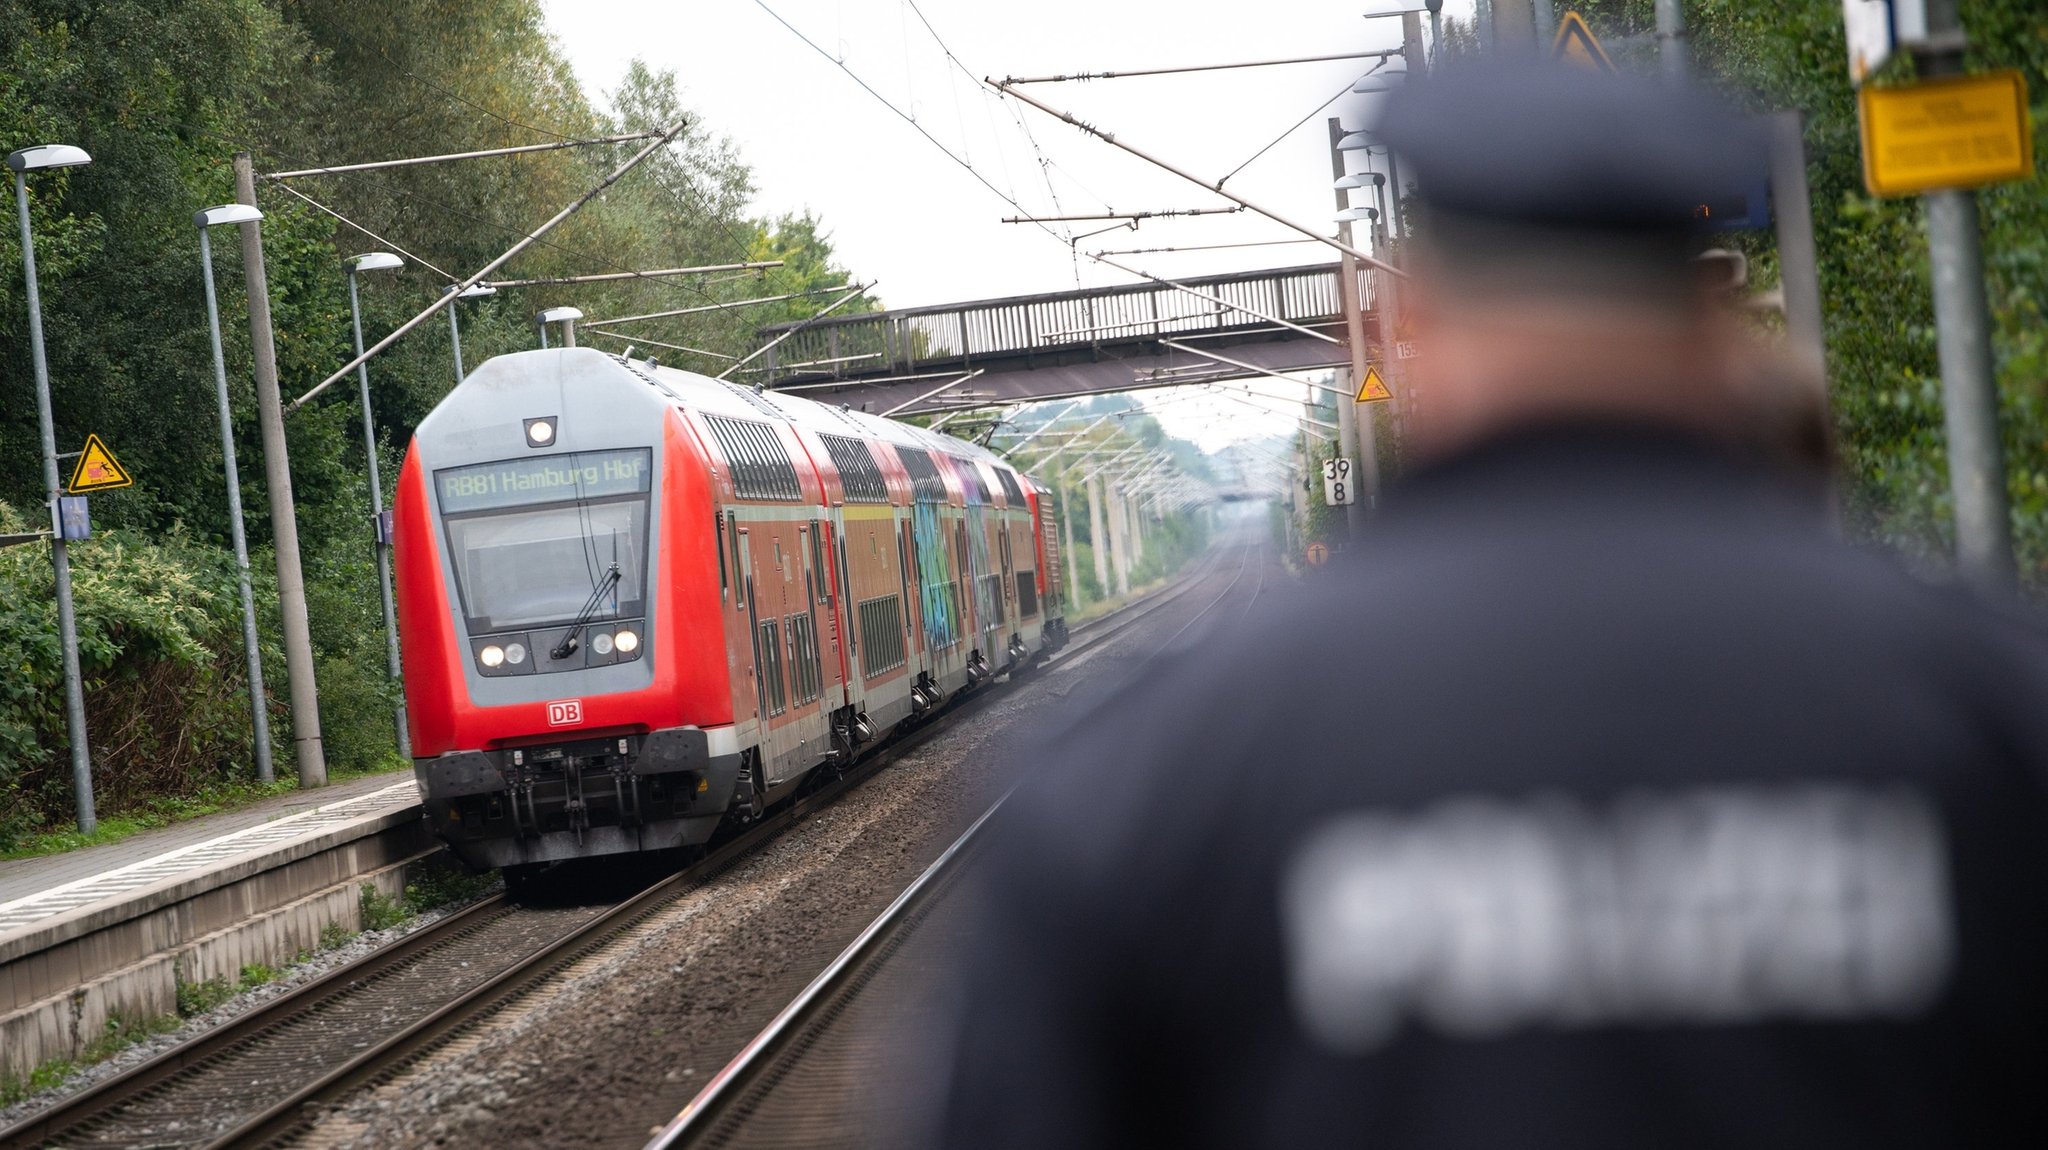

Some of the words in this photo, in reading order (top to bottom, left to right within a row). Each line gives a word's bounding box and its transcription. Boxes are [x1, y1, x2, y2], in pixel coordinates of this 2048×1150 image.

[444, 474, 497, 498] RB81
[502, 465, 599, 492] Hamburg
[603, 457, 643, 481] Hbf
[1326, 460, 1350, 480] 39
[1334, 482, 1345, 501] 8
[551, 703, 579, 722] DB
